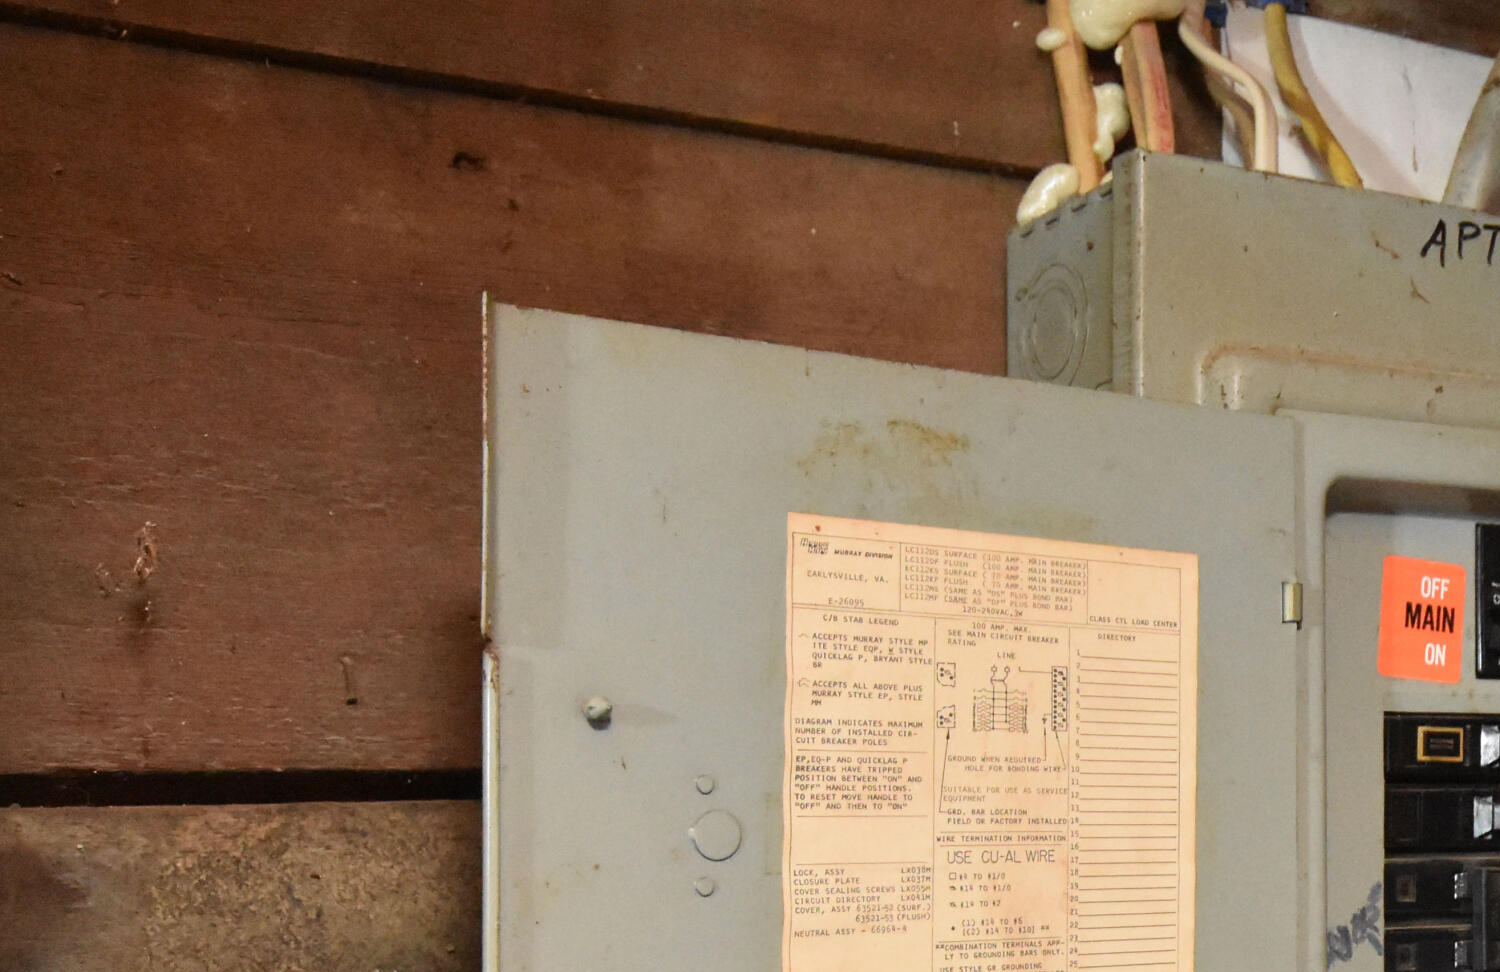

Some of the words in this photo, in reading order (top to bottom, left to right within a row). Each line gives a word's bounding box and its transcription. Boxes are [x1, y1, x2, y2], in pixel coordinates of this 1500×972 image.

[865, 552, 893, 560] DIVISION
[1421, 576, 1450, 599] OFF
[843, 615, 864, 624] STAB
[869, 616, 899, 626] LEGEND
[1405, 602, 1455, 633] MAIN
[1132, 618, 1149, 626] LOAD
[1153, 620, 1178, 628] CENTER
[812, 632, 848, 641] ACCEPTS
[853, 635, 882, 644] MURRAY
[948, 629, 961, 637] SEE
[990, 632, 1022, 641] CIRCUIT
[1028, 635, 1059, 644] BREAKER
[1098, 633, 1136, 642] DIRECTORY
[948, 638, 976, 647] RATING
[833, 643, 858, 651] STYLE
[899, 647, 923, 655] STYLE
[812, 652, 853, 661] QUICKLAG
[874, 655, 903, 663] BRYANT
[908, 657, 933, 665] STYLE
[997, 652, 1016, 660] LINE
[1424, 643, 1446, 666] ON
[812, 680, 848, 689] ACCEPTS
[853, 682, 868, 690] ALL
[873, 683, 898, 691] ABOVE
[812, 690, 842, 698] MURRAY
[848, 691, 872, 699] STYLE
[795, 717, 832, 725] DIAGRAM
[838, 718, 882, 727] INDICATES
[888, 720, 923, 728] MAXIMUM
[848, 728, 892, 736] INSTALLED
[862, 738, 888, 746] POLES
[857, 756, 898, 764] QUICKLAG
[948, 754, 976, 762] GROUND
[981, 755, 1000, 763] WHEN
[795, 774, 836, 782] POSITION
[862, 784, 911, 792] POSITIONS.
[942, 785, 981, 793] SUITABLE
[1036, 787, 1068, 795] SERVICE
[795, 802, 820, 810] "OFF"
[847, 802, 868, 810] THEN
[990, 808, 1027, 816] LOCATION
[990, 817, 1022, 825] FACTORY
[1017, 834, 1066, 842] INFORMATION
[947, 850, 972, 864] USE
[981, 850, 1022, 864] CU-AL
[1025, 849, 1055, 863] WIRE
[794, 869, 818, 877] LOCK,
[794, 878, 829, 886] CLOSURE
[825, 887, 860, 895] SEALING
[836, 895, 880, 903] DIRECTORY
[831, 905, 851, 913] ASSY
[896, 912, 931, 921] (FLUSH)
[794, 930, 830, 938] NEUTRAL
[836, 928, 856, 936] ASSY
[1002, 940, 1042, 949] TERMINALS
[974, 951, 1014, 959] GROUNDING
[959, 965, 981, 972] STYLE
[1001, 963, 1042, 971] GROUNDING
